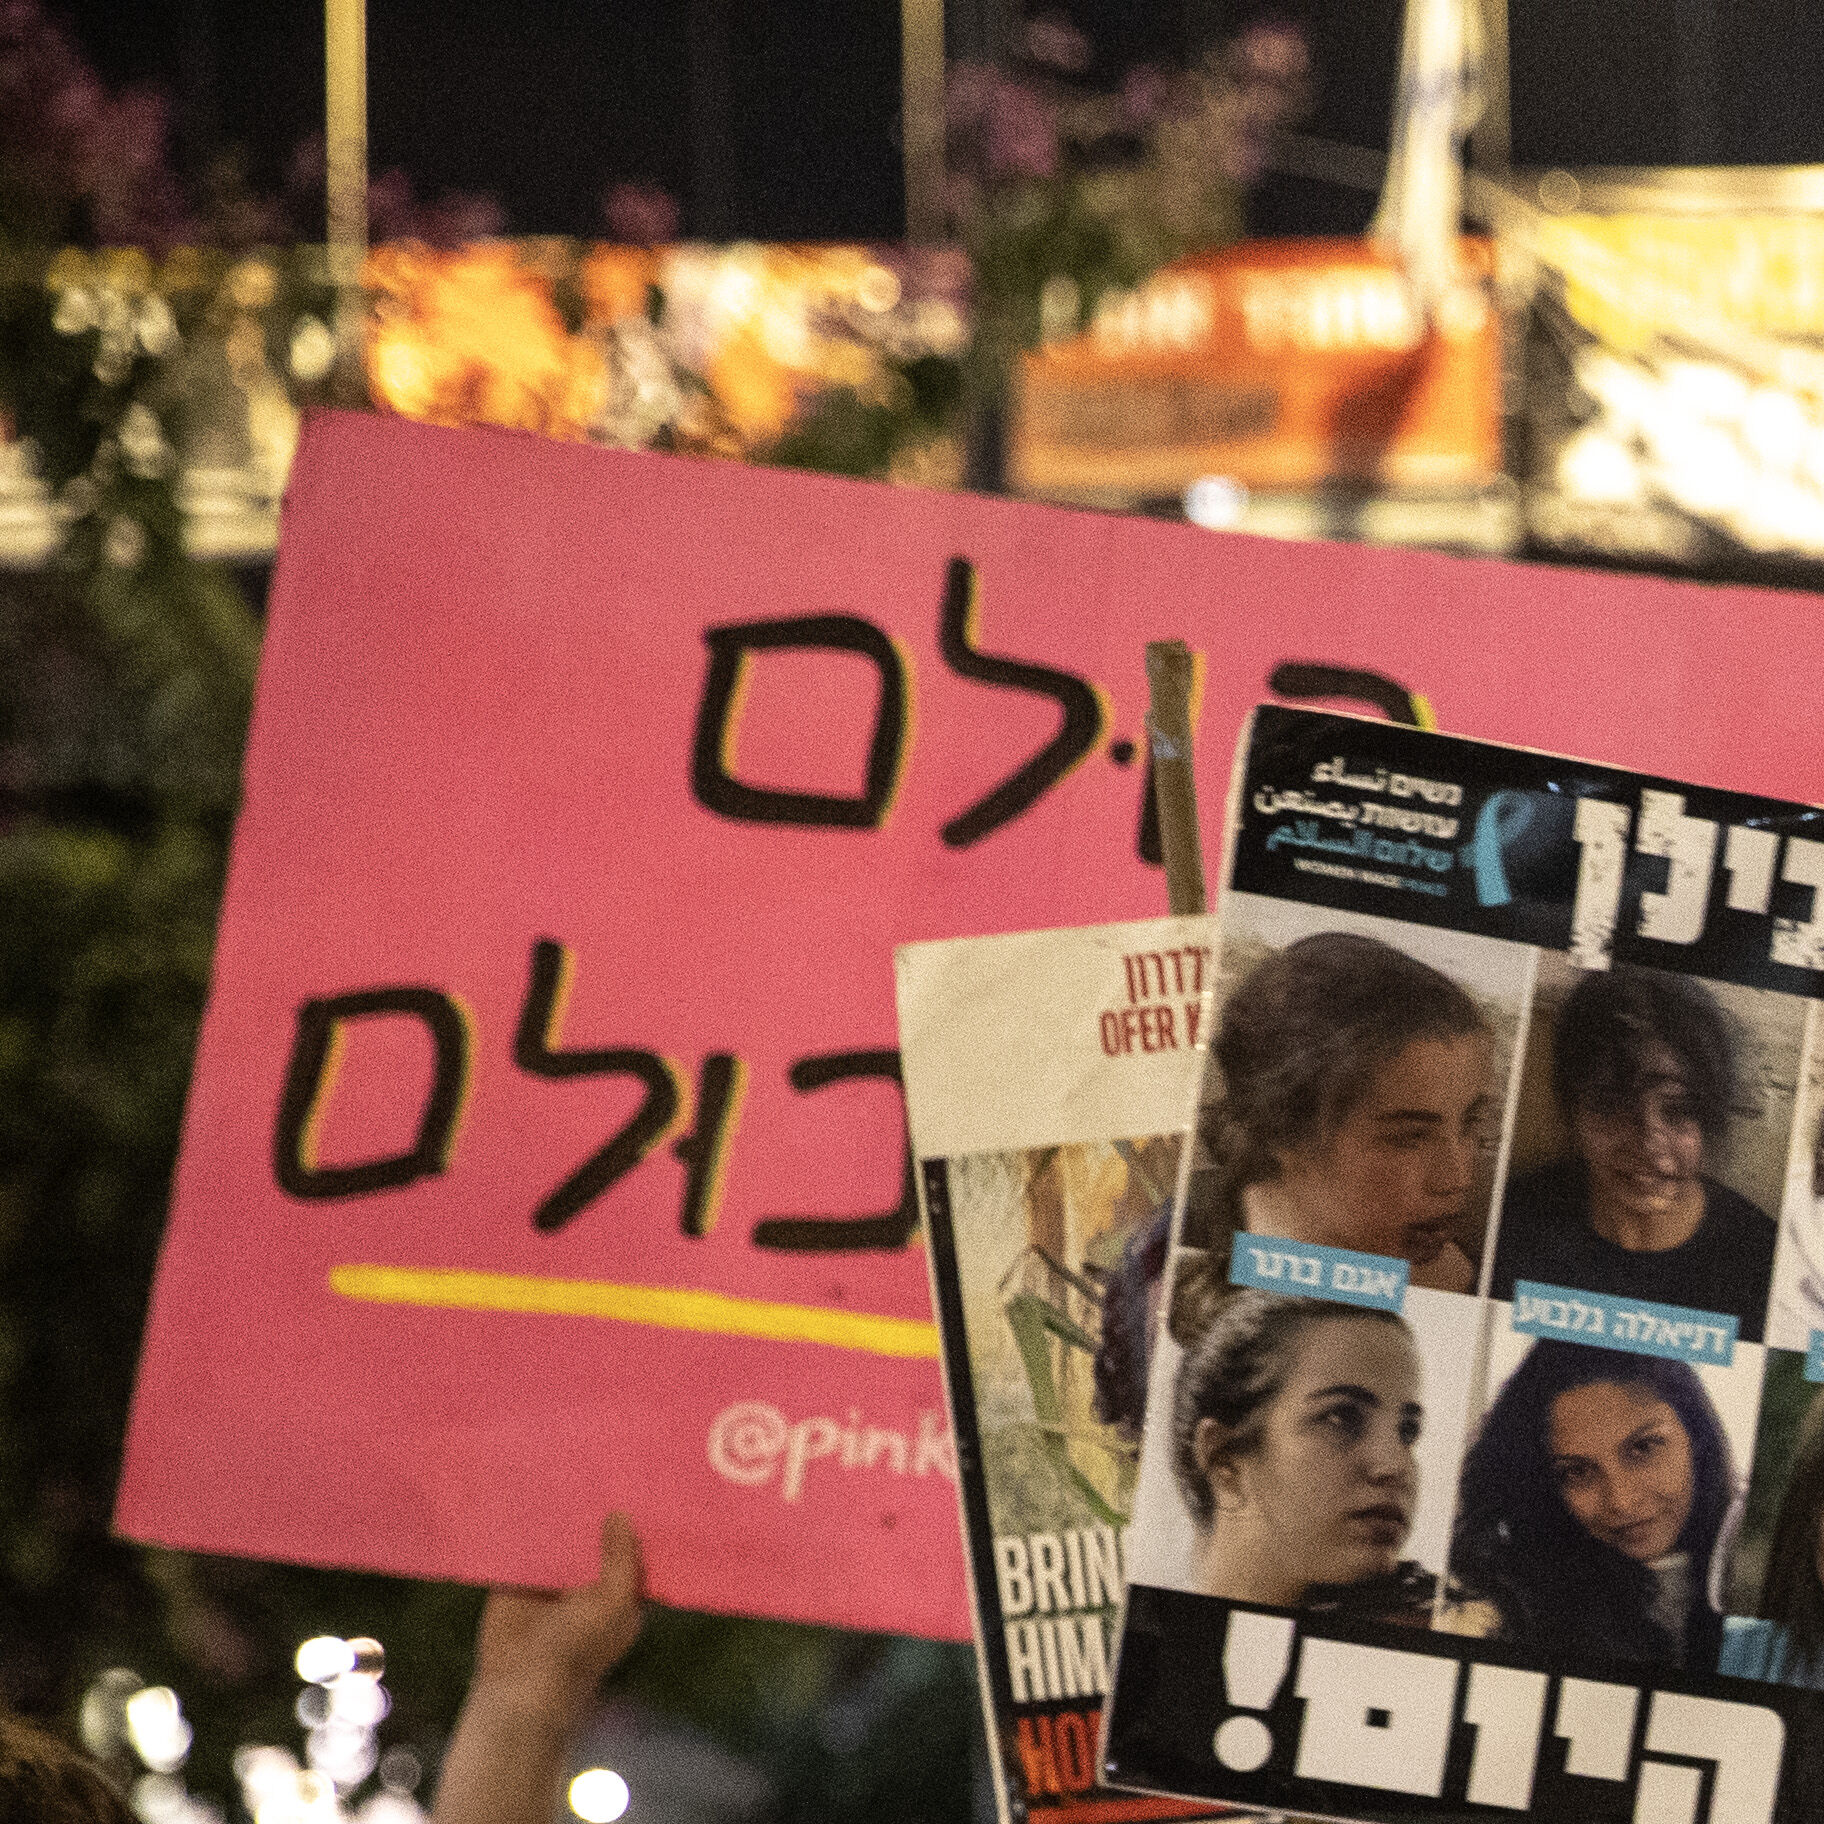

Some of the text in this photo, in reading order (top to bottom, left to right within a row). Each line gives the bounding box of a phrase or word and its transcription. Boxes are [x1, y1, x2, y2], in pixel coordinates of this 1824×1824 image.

[1100, 1004, 1178, 1057] OFER
[1331, 1262, 1399, 1299] אגם
[1514, 1295, 1729, 1354] דניאלה גלבוע
[1016, 1710, 1102, 1796] HO
